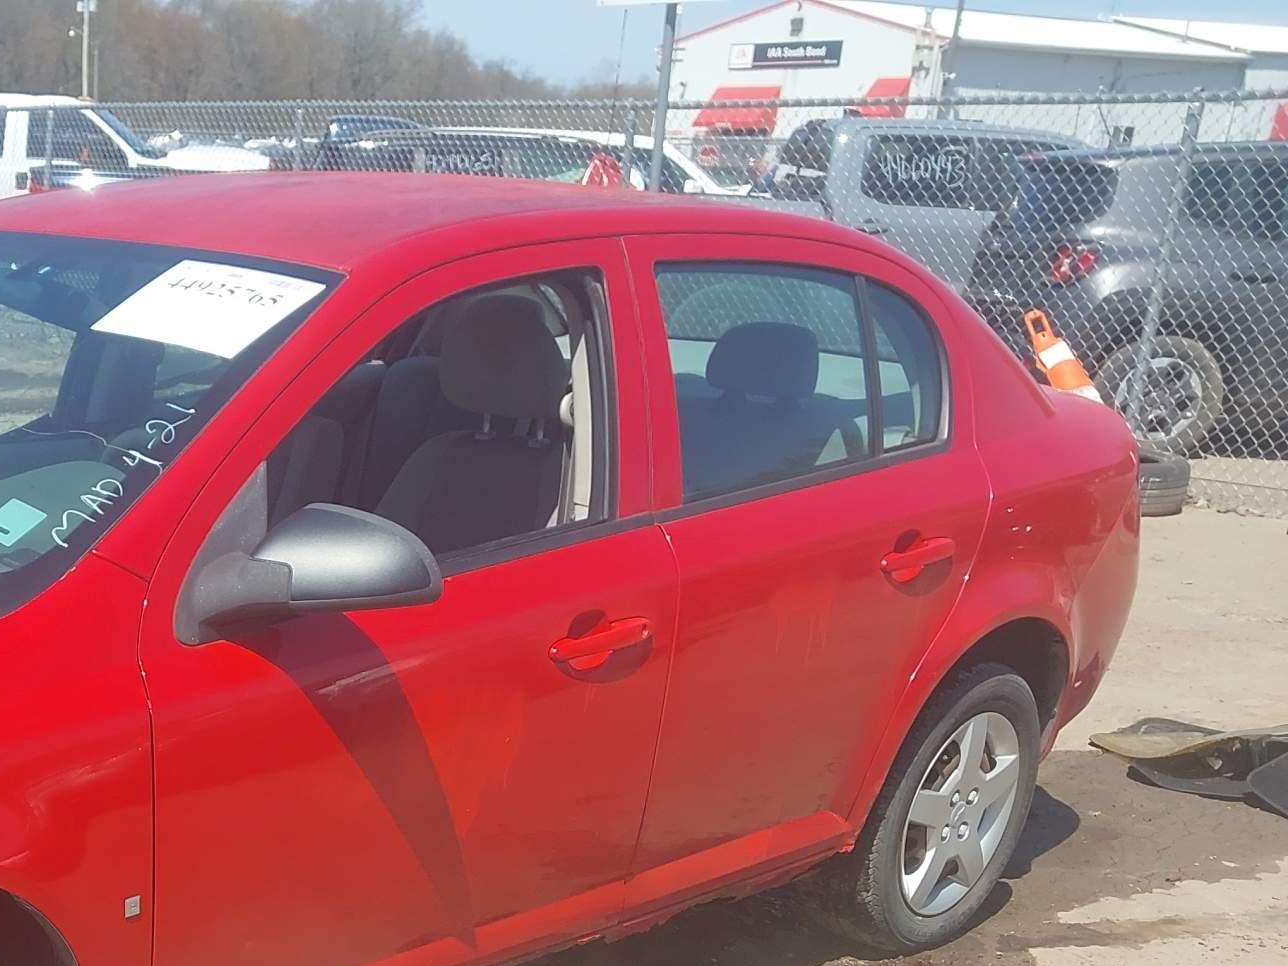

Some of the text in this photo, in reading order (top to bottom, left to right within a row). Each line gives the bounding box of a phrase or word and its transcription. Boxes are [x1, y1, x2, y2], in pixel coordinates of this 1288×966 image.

[767, 45, 827, 58] IAA South Bend
[51, 478, 124, 548] MAD
